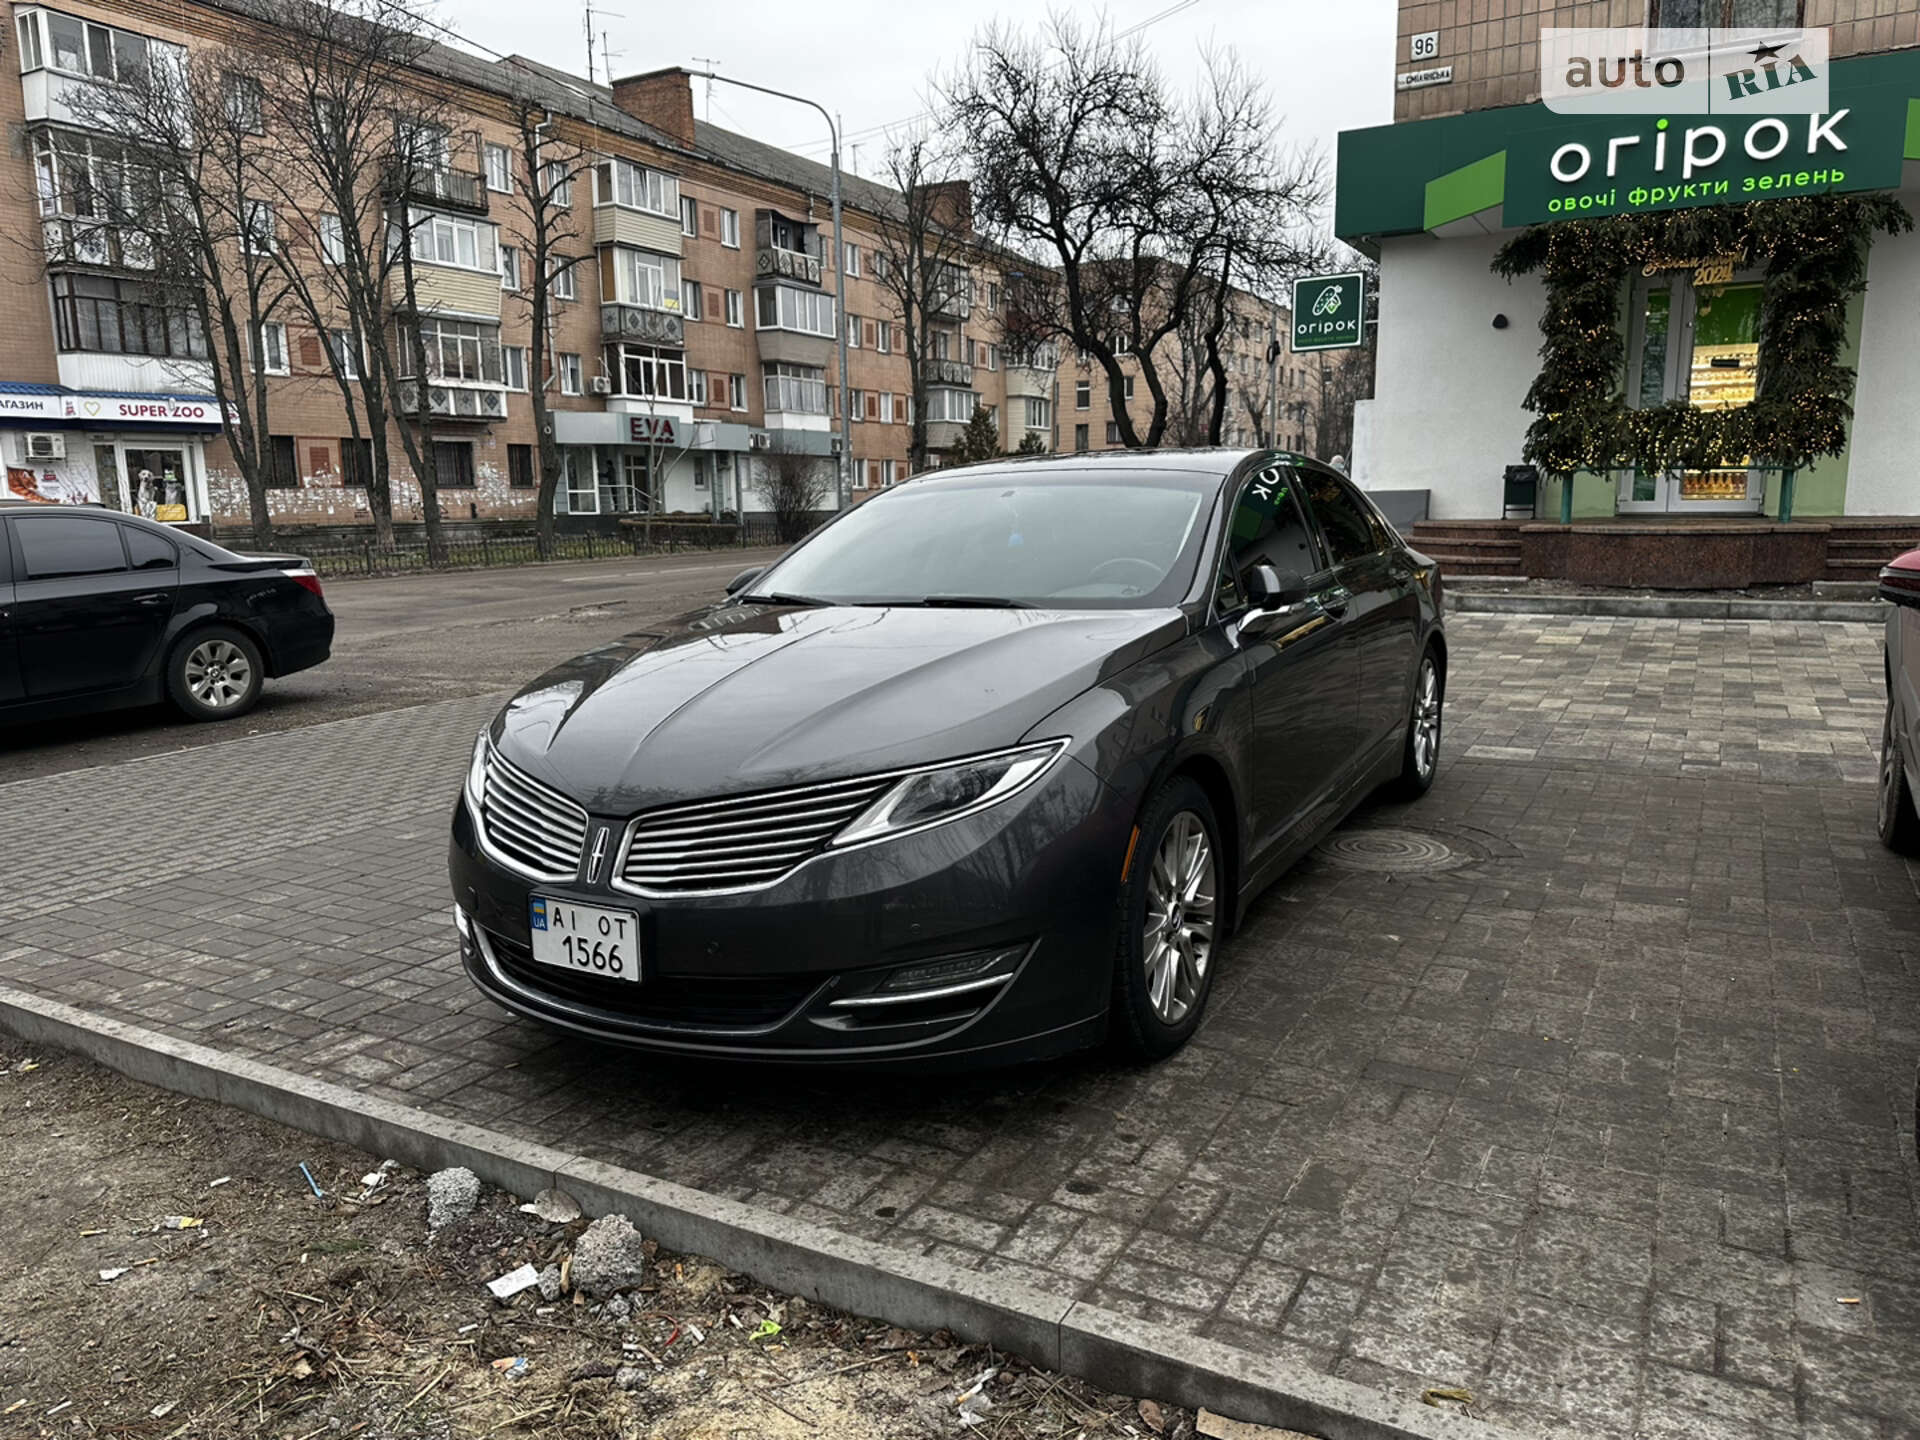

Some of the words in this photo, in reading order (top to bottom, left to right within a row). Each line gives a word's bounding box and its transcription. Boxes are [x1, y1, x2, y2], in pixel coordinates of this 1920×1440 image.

[1415, 37, 1434, 55] 96
[1550, 108, 1851, 182] огірок
[1548, 189, 1616, 212] овочі
[1628, 178, 1729, 206] фрукти
[1742, 168, 1845, 192] зелень
[1297, 320, 1356, 334] огірок
[119, 404, 168, 417] SUPER
[172, 406, 205, 418] ZOO
[630, 416, 674, 436] EVA
[534, 917, 546, 928] UA
[553, 907, 576, 931] AI
[598, 916, 628, 939] OT
[562, 935, 623, 973] 1566
